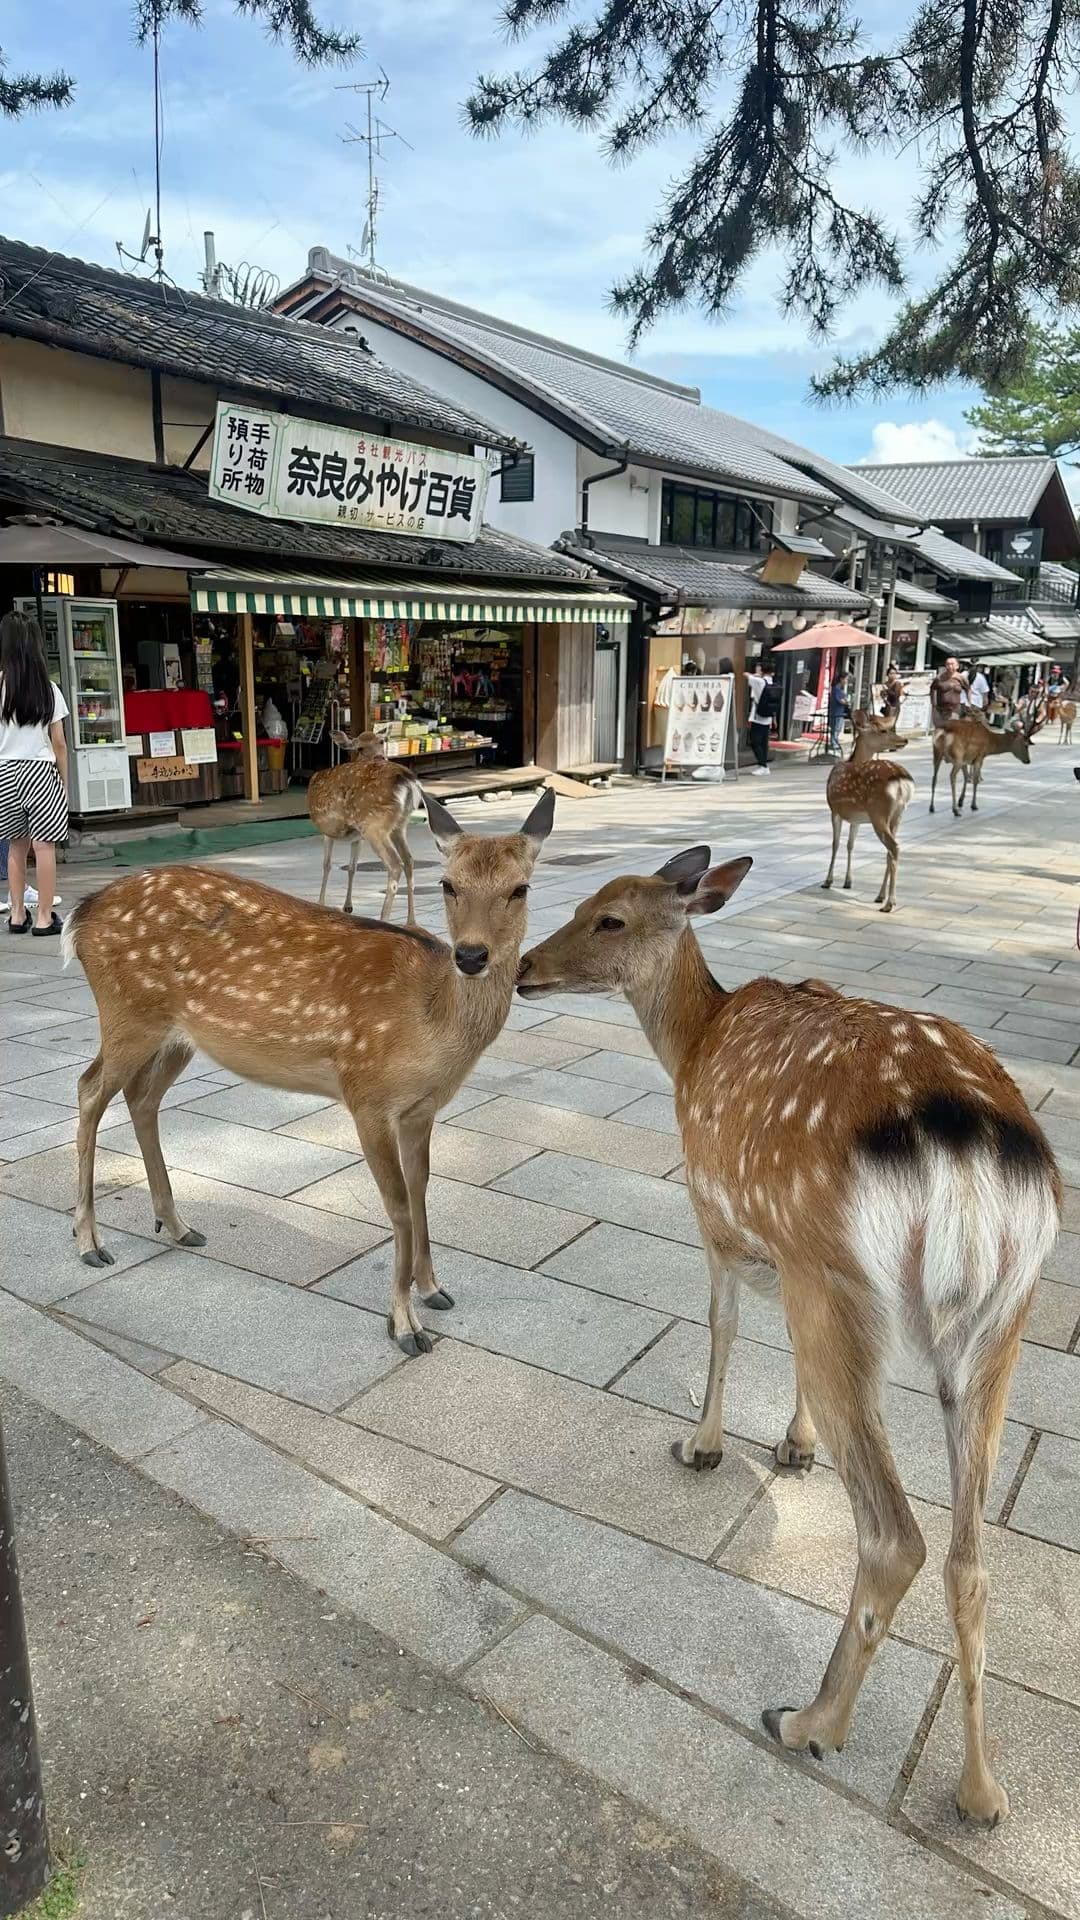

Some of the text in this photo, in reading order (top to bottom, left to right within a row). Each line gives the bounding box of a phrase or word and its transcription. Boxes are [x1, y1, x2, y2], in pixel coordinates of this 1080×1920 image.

[220, 416, 249, 492] 預り所
[244, 423, 270, 495] 手荷物
[287, 445, 476, 521] 奈良みやげ百貨
[357, 440, 427, 466] 各社観光バス
[680, 681, 722, 689] CREMIA
